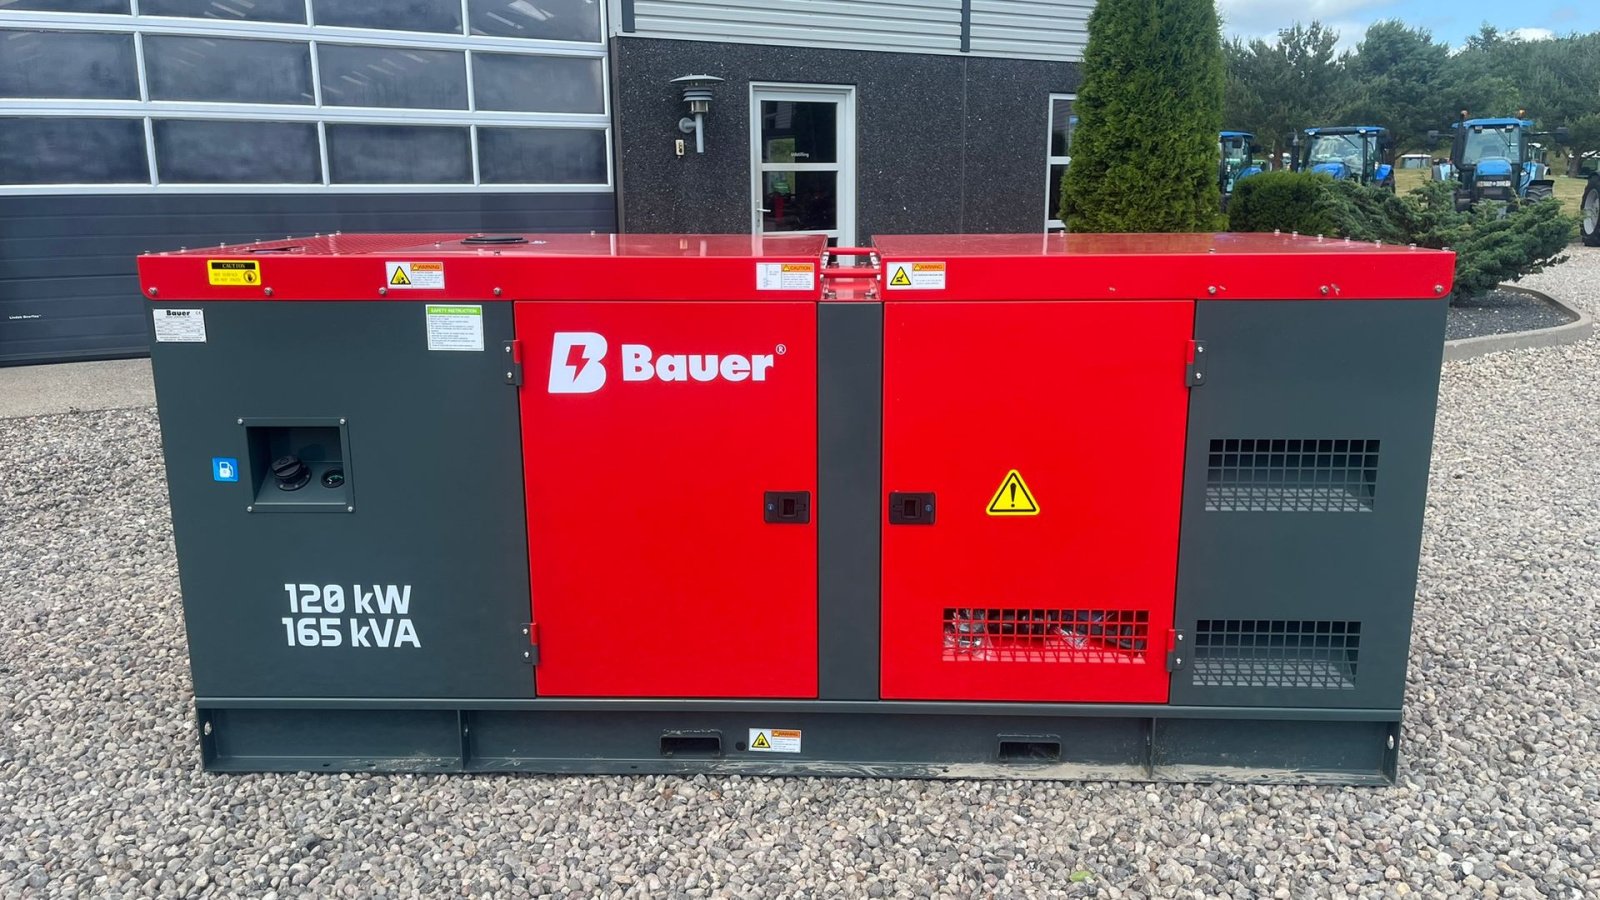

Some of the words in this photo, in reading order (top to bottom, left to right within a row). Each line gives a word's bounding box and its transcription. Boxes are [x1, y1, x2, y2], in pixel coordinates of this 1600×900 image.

[284, 583, 345, 613] 120
[353, 584, 412, 614] kW
[281, 617, 343, 647] 165
[349, 618, 422, 648] kVA
